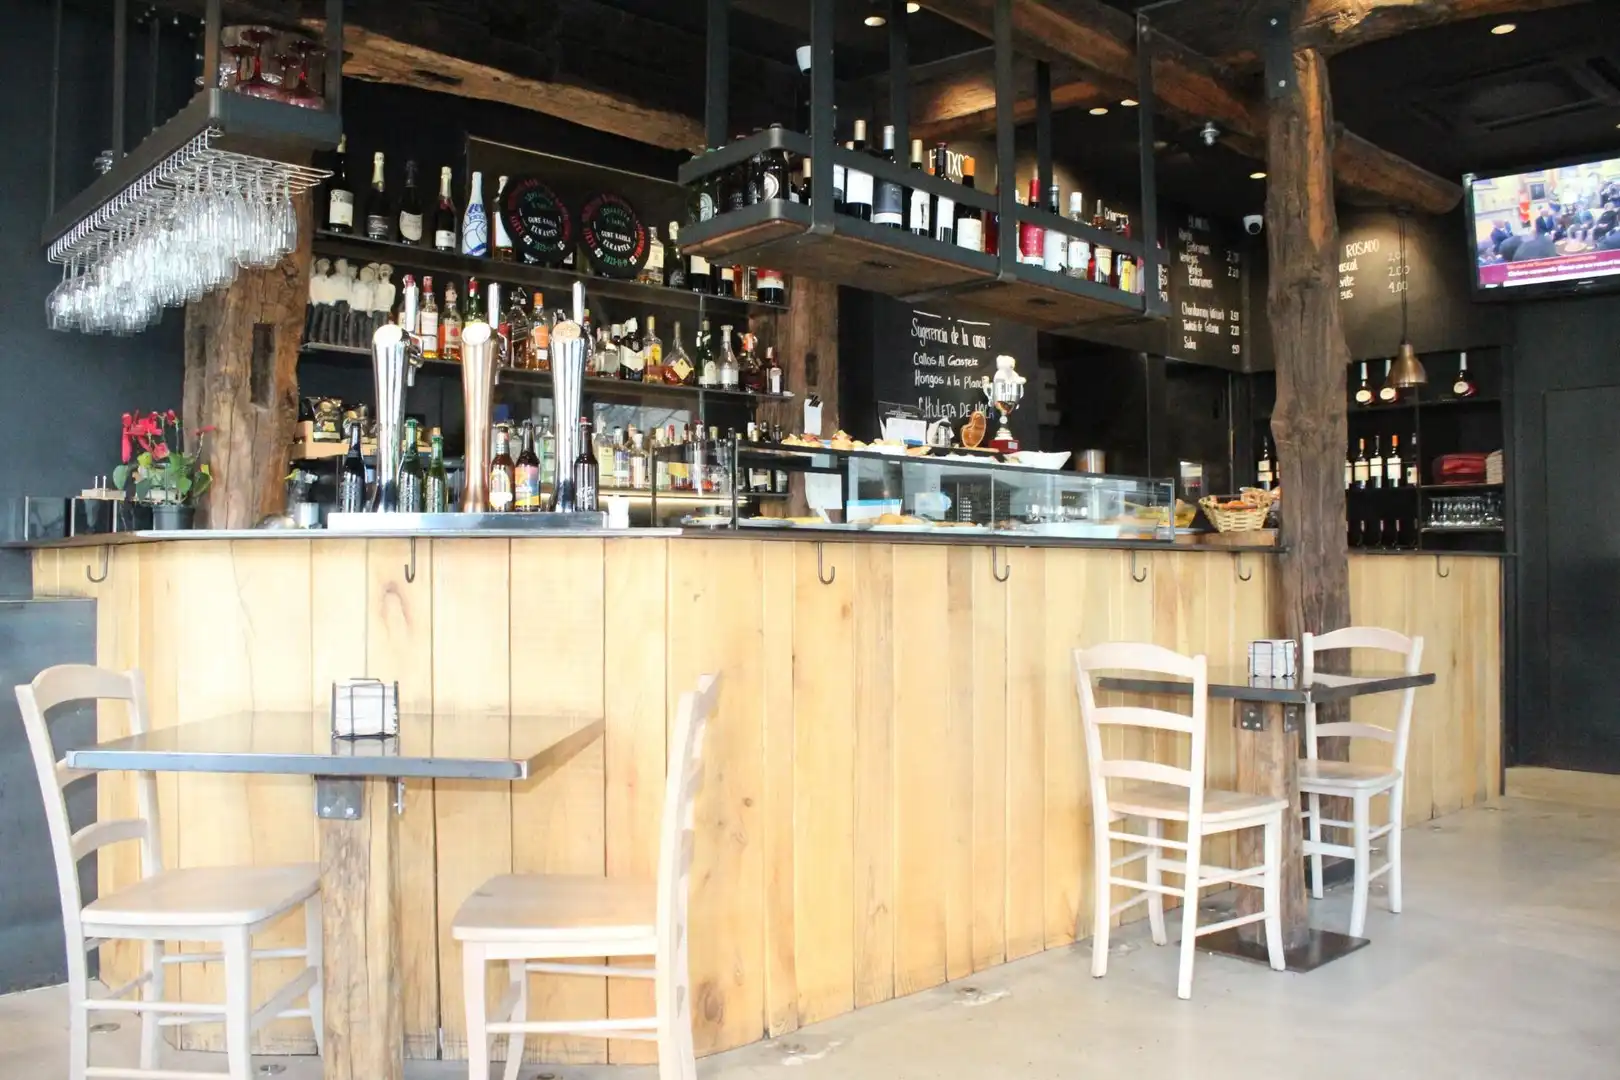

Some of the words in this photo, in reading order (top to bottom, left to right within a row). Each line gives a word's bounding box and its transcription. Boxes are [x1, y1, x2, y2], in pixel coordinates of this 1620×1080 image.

[1346, 239, 1380, 259] ROSADO
[951, 325, 959, 345] de
[961, 327, 969, 346] la
[913, 351, 937, 367] Callos
[914, 369, 945, 389] Hongos
[953, 374, 961, 388] la
[918, 396, 957, 419] CHULETA
[959, 402, 972, 419] DE
